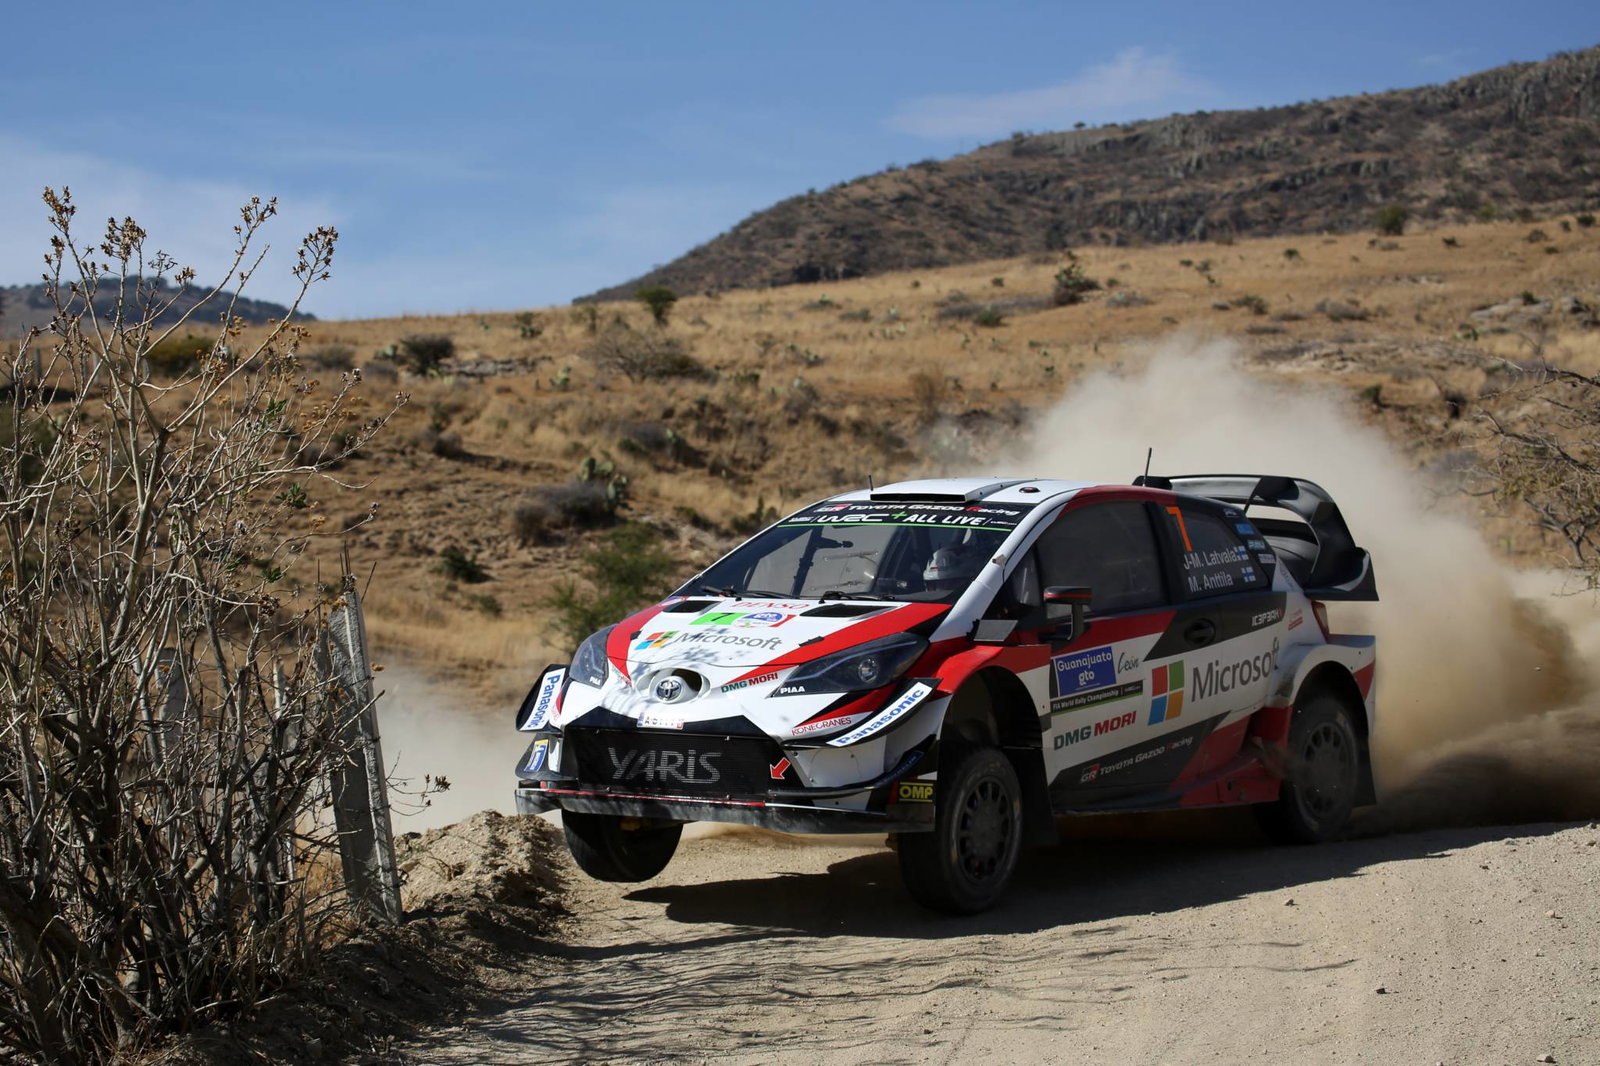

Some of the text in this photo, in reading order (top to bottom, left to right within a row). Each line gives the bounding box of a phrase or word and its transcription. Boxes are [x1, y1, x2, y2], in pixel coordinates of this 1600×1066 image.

[903, 514, 938, 523] ALL
[941, 515, 986, 525] LIVE
[908, 504, 965, 512] GAZOO
[965, 506, 1021, 516] Racing
[1165, 506, 1193, 551] 7
[1183, 553, 1204, 570] J-M.
[1204, 548, 1238, 566] Latvala
[1187, 572, 1234, 593] M. Anttila
[710, 612, 736, 622] 7
[674, 632, 782, 651] Microsoft
[1057, 652, 1112, 672] Guanajuato
[721, 673, 778, 694] DMG MORI
[1078, 670, 1095, 686] gto
[780, 686, 806, 695] PIAA
[527, 674, 561, 728] Panasonic
[791, 717, 852, 736] KONECRANES
[836, 689, 925, 745] Panasonic
[1053, 711, 1137, 751] DMG MORI
[1100, 757, 1135, 775] TOYOTA
[1135, 746, 1165, 764] GAZOO
[899, 785, 934, 799] OMP
